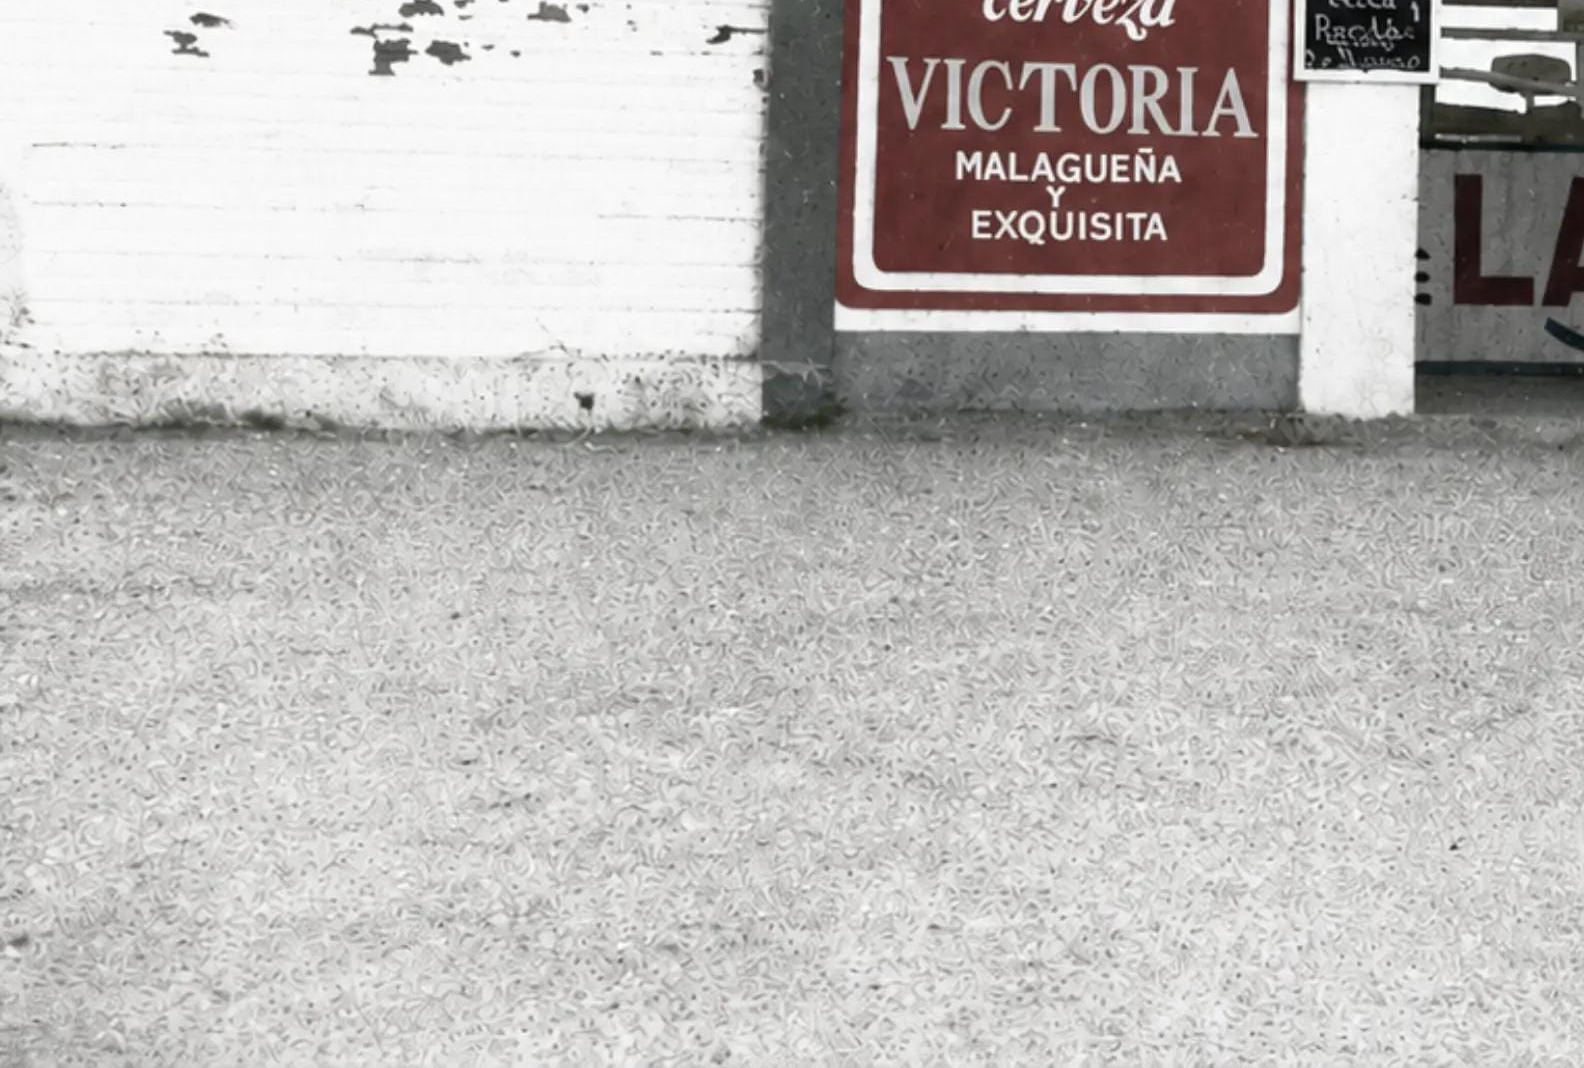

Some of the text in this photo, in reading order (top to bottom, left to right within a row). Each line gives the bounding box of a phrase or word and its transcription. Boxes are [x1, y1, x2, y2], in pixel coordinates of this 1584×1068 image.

[886, 55, 1259, 138] VICTORIA
[955, 147, 1182, 184] MALAGUEÑA
[1045, 185, 1067, 209] Y
[971, 210, 1168, 245] EXQUISITA
